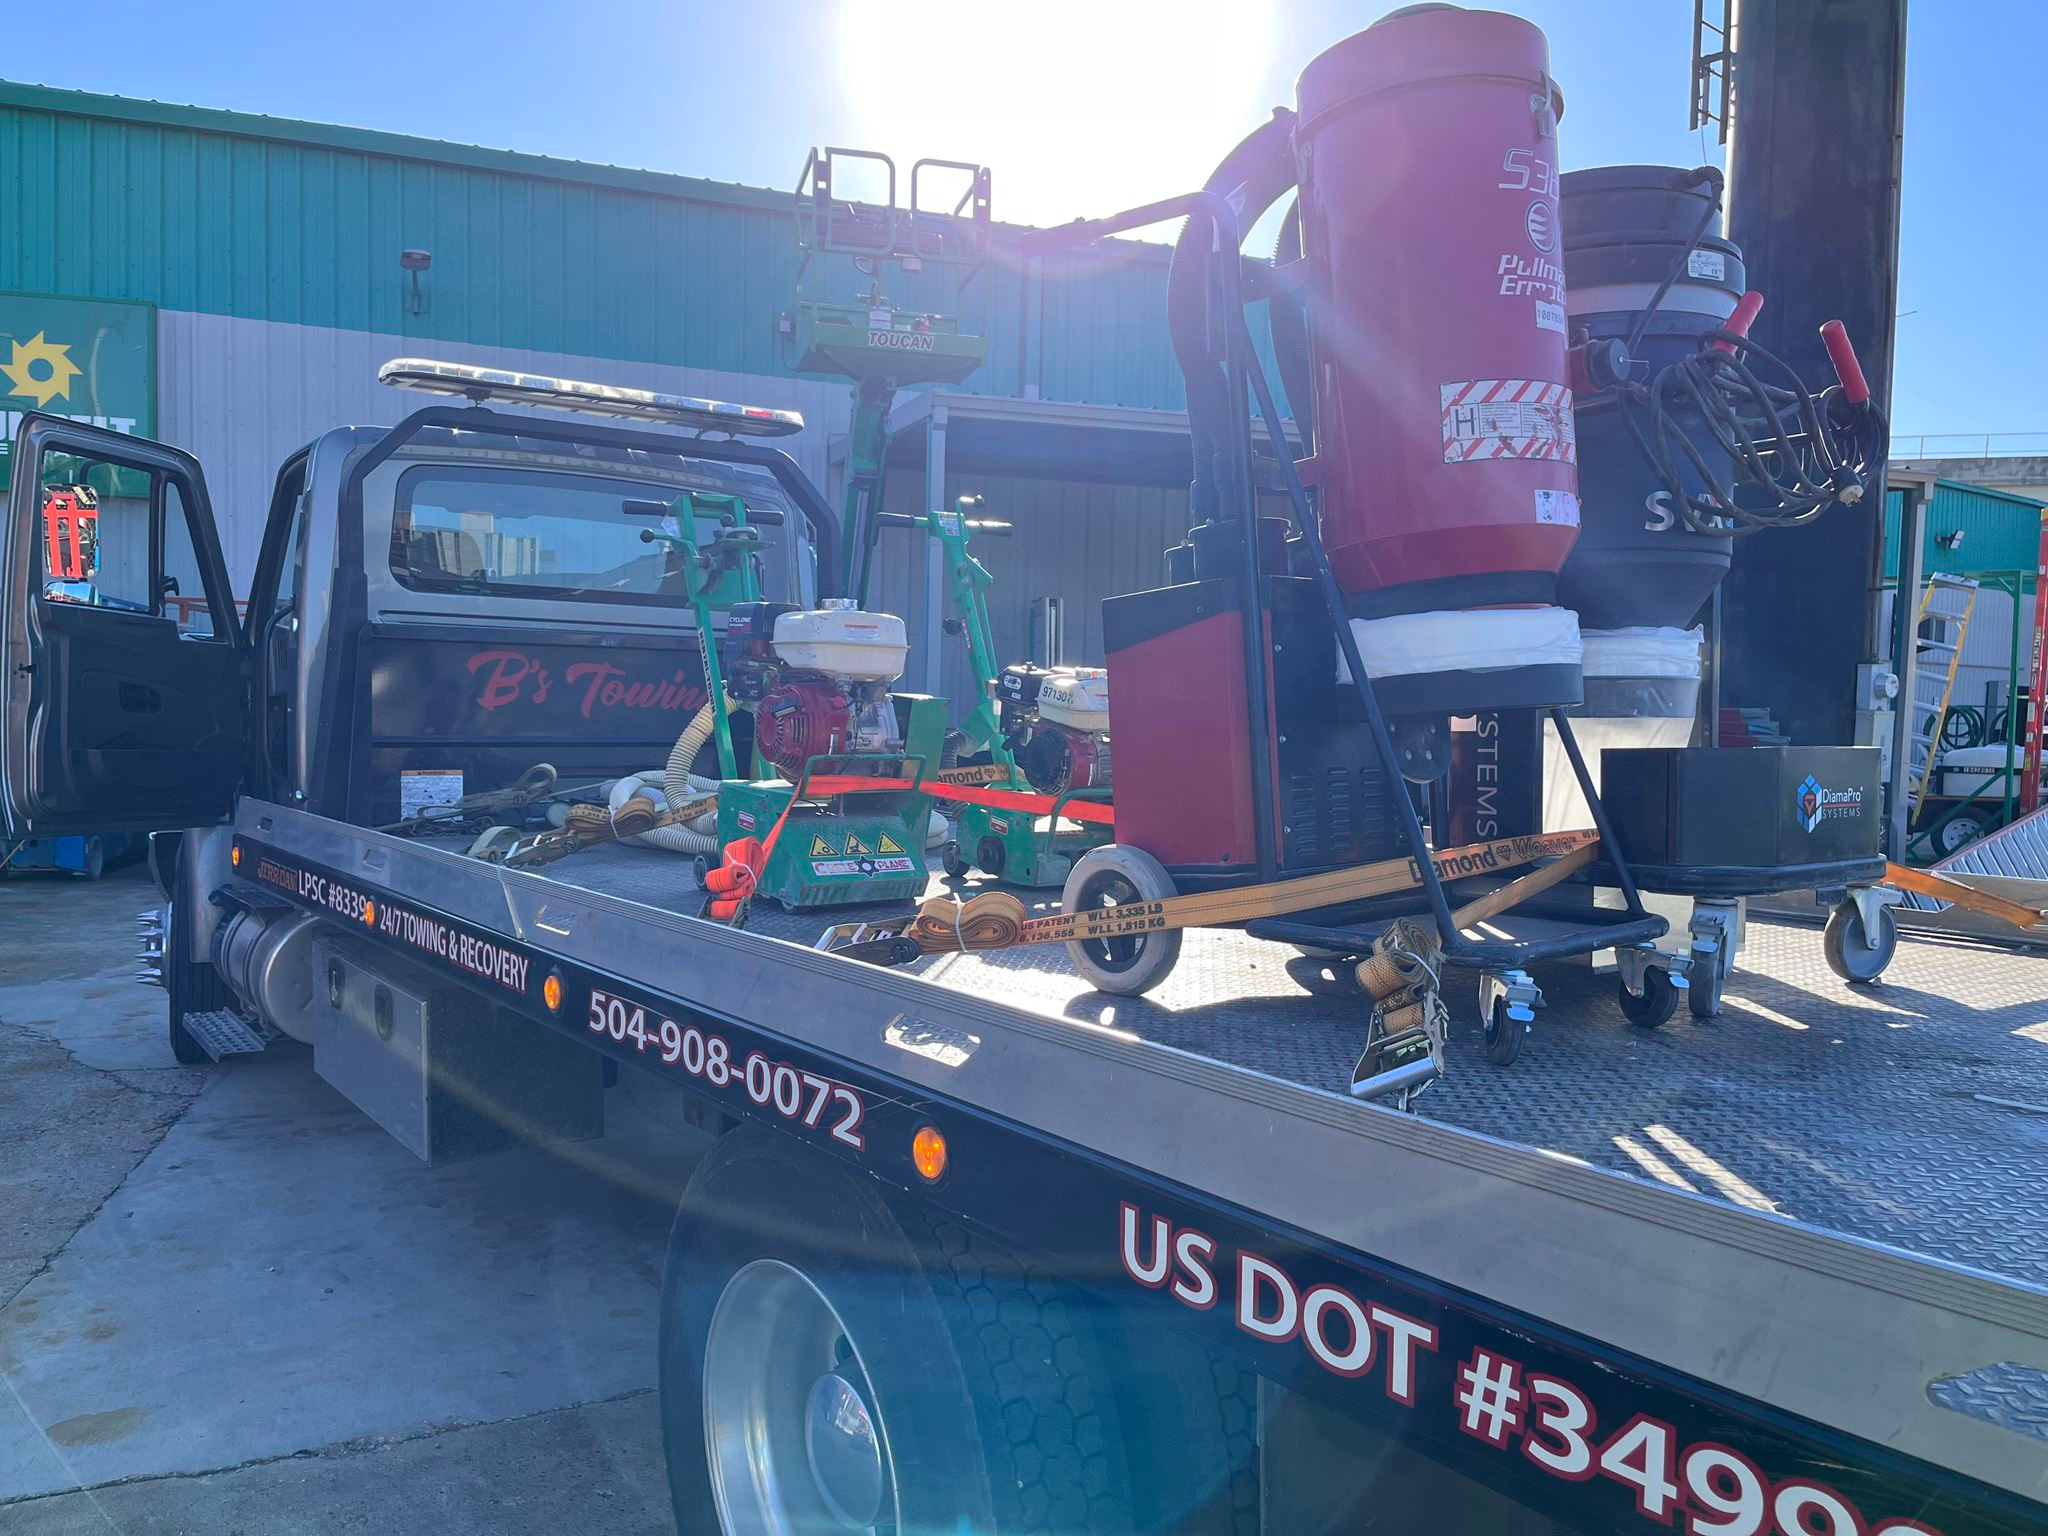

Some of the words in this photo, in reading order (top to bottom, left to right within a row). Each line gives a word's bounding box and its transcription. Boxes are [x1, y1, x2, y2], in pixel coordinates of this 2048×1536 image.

[868, 331, 935, 351] TOUCAN
[1454, 407, 1475, 437] H
[467, 650, 553, 711] B's
[566, 661, 710, 719] Towin
[1475, 713, 1500, 838] STEMS
[1822, 807, 1861, 819] SYSTEMS
[1408, 844, 1499, 883] Damond
[298, 868, 327, 905] LPSC
[1020, 921, 1035, 931] US
[1036, 915, 1077, 929] PATENT
[1087, 910, 1114, 922] WLL
[1147, 902, 1163, 914] LB
[1087, 924, 1114, 936] WLL
[1116, 919, 1146, 932] 1,515
[1147, 916, 1166, 929] KG
[379, 904, 402, 937] 24/7
[402, 911, 446, 956] TOWING
[449, 929, 459, 962] &
[459, 933, 529, 992] RECOVERY
[588, 989, 864, 1150] 504-908-0072
[1121, 1203, 1216, 1308] US
[1239, 1251, 1436, 1402] DOT
